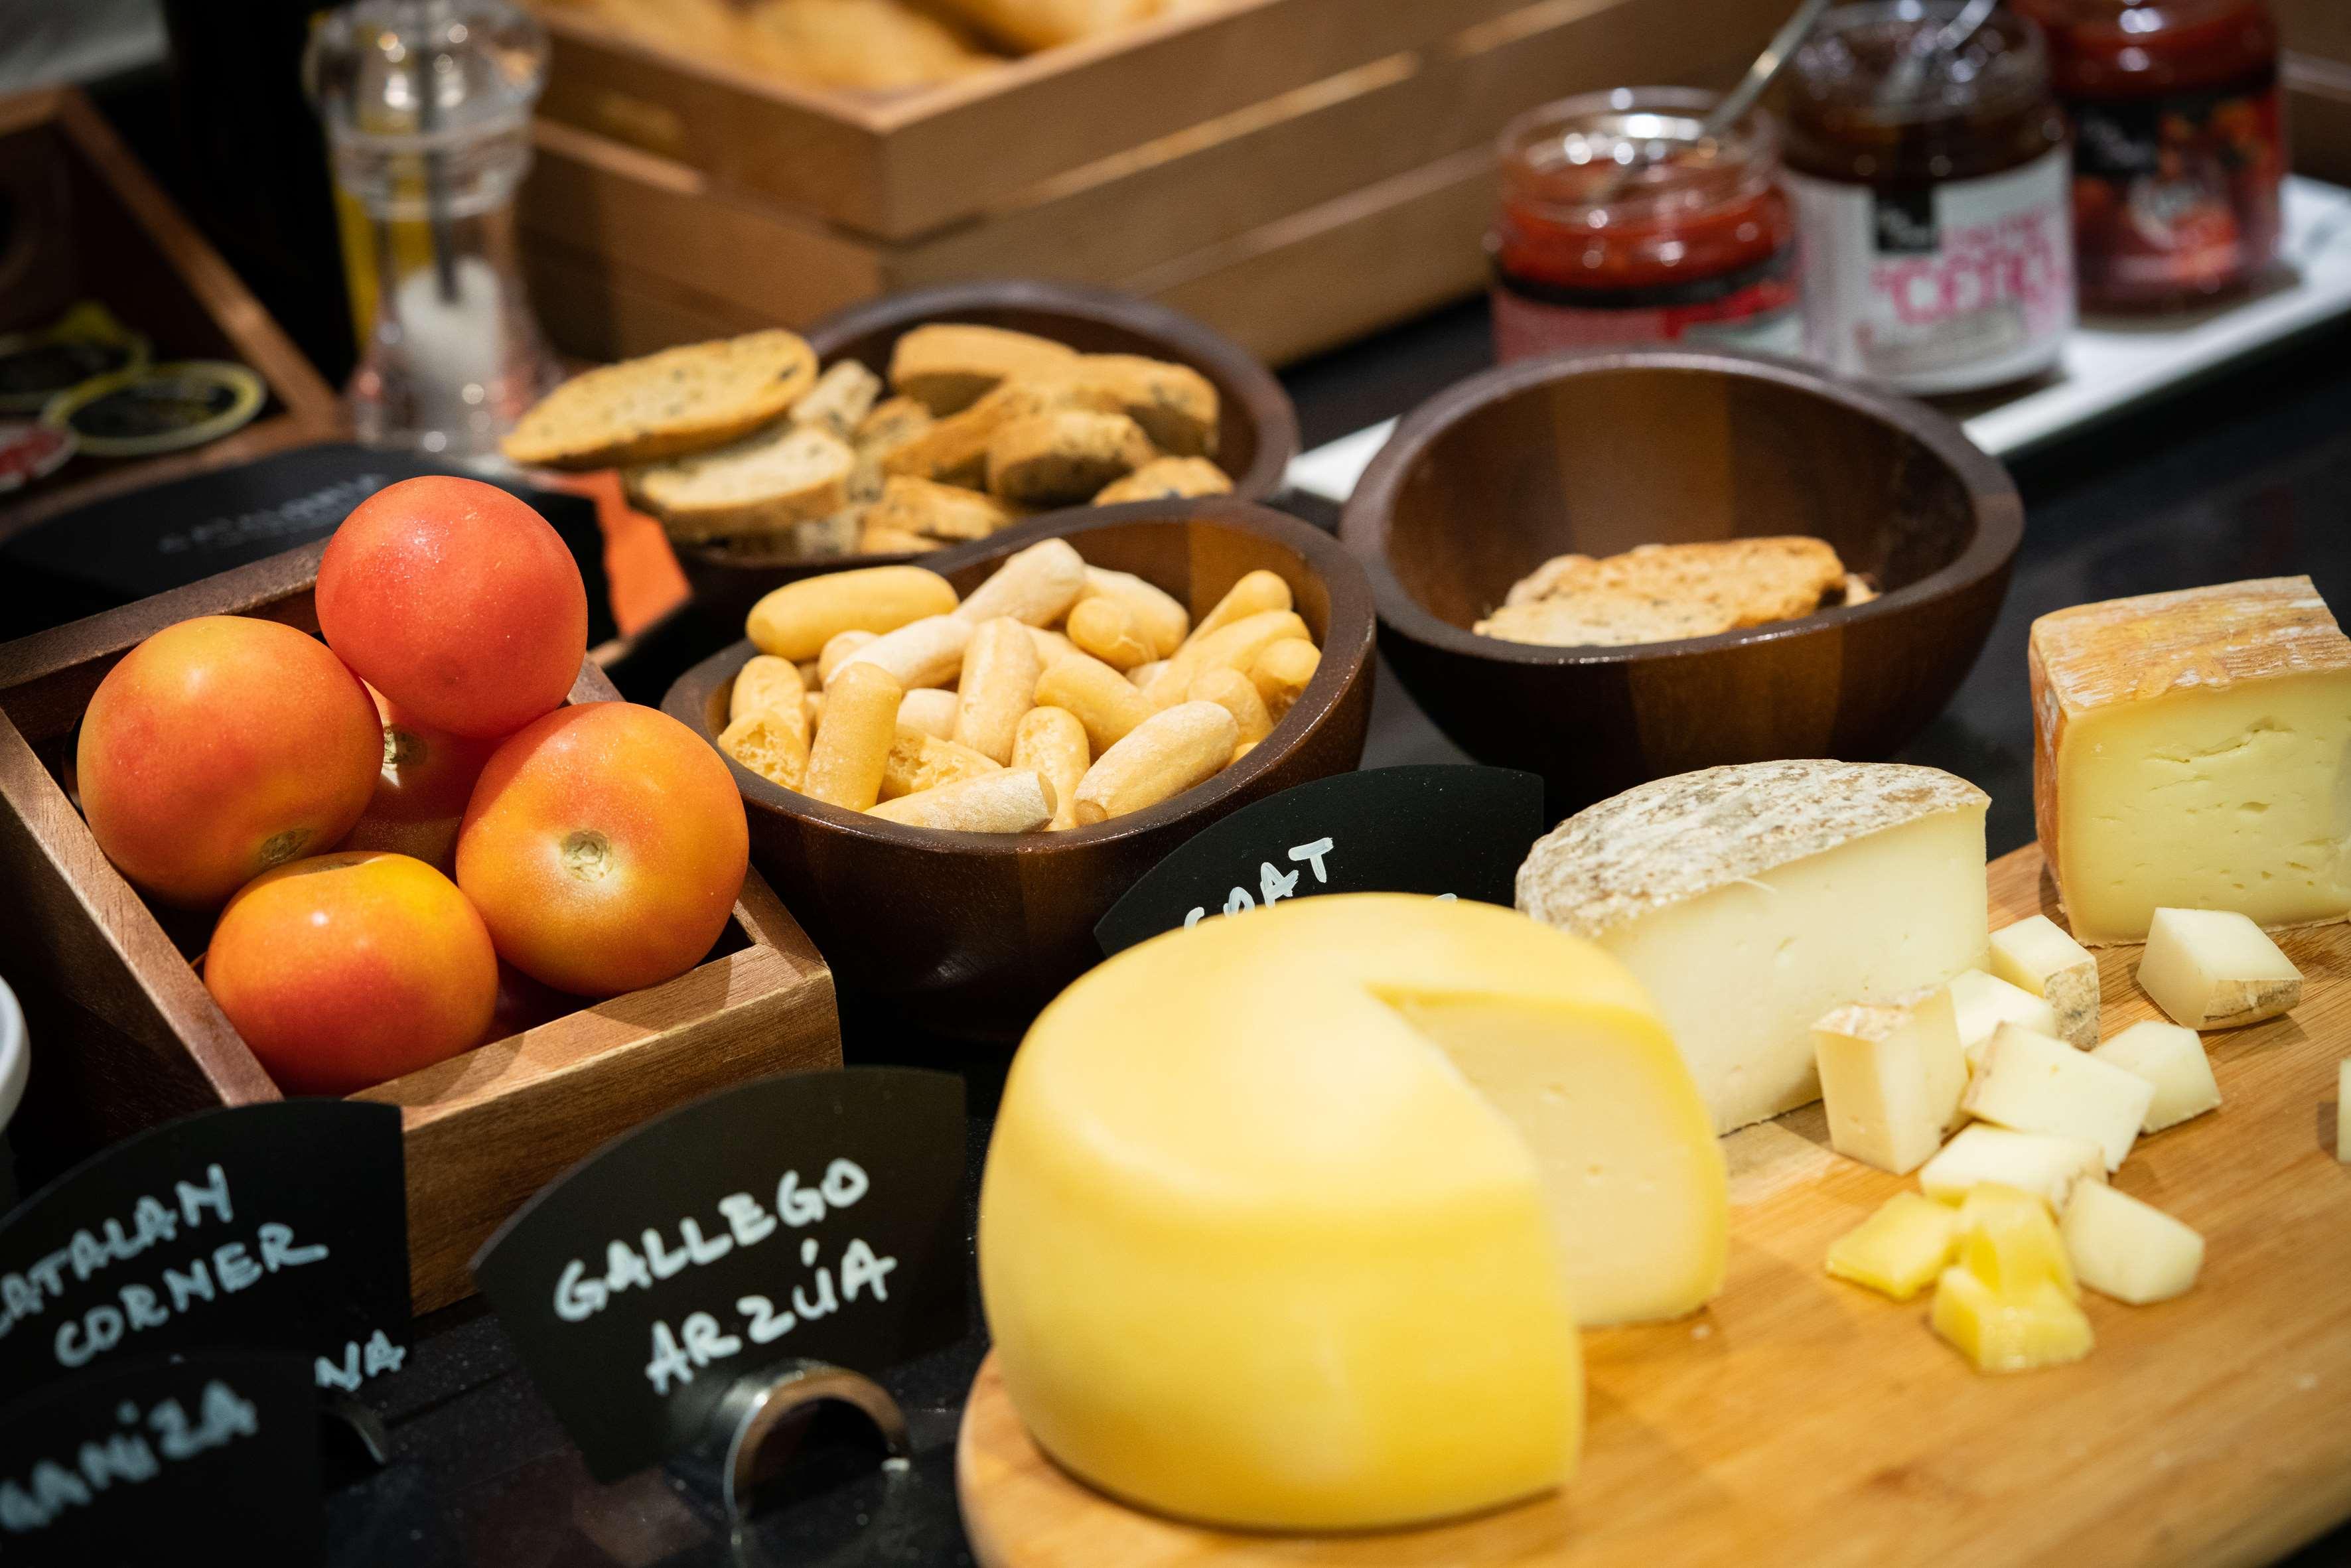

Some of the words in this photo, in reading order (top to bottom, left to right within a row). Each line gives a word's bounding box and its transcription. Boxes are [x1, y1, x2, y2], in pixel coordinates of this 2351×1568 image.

[0, 1163, 234, 1337] ATALAN
[54, 1222, 330, 1366] CORNER
[553, 1157, 870, 1322] GALLEGO
[645, 1237, 898, 1395] ARZÚA
